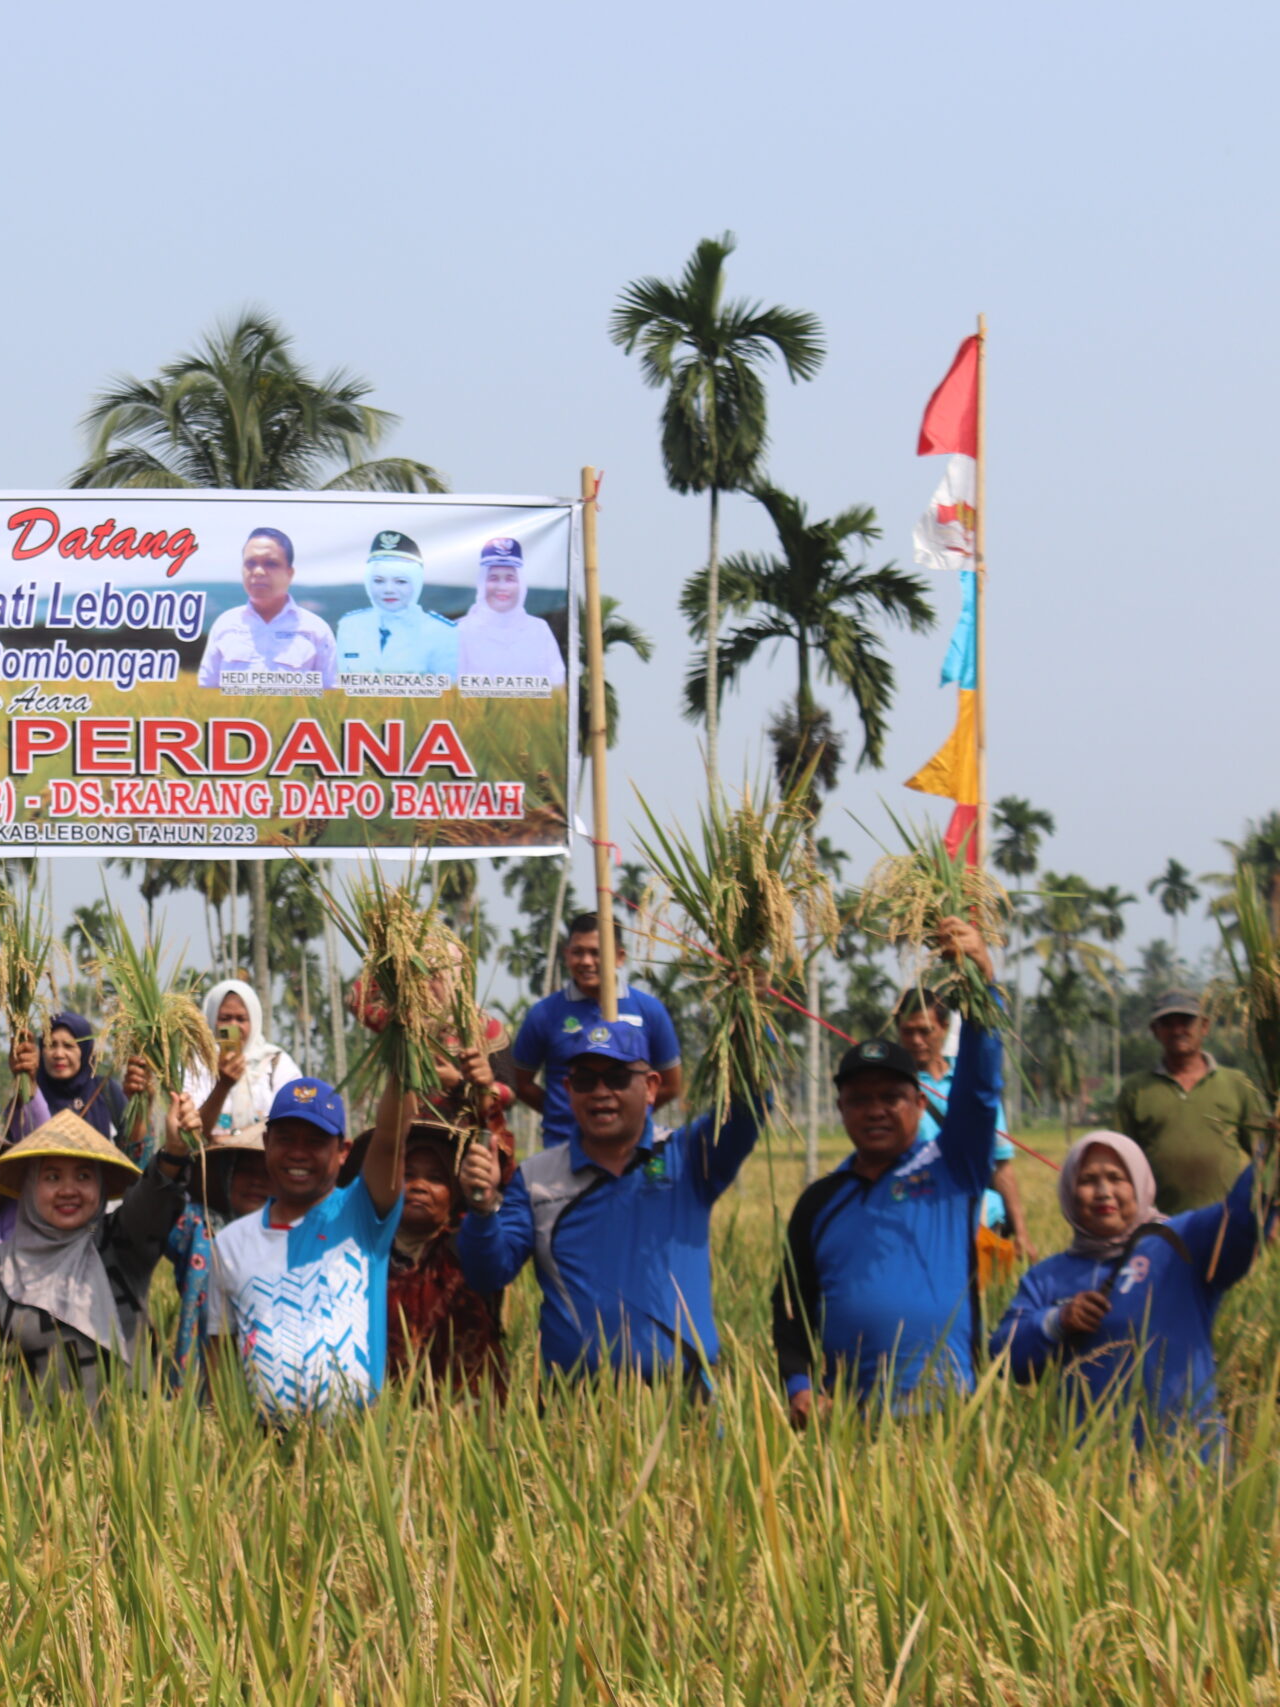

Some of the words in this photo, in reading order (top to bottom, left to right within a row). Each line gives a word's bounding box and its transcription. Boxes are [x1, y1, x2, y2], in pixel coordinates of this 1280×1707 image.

[7, 507, 199, 578] Datang
[48, 581, 205, 640] Lebong
[221, 672, 249, 684] HEDI
[340, 673, 381, 687] MEIKA
[460, 676, 492, 688] EKA
[495, 676, 550, 688] PATRIA
[7, 686, 91, 712] Acara
[12, 717, 477, 777] PERDANA
[50, 780, 273, 818] DS.KARANG
[281, 781, 384, 819] DAPO
[393, 782, 525, 819] BAWAH
[137, 825, 206, 842] TAHUN
[210, 826, 257, 842] 2023
